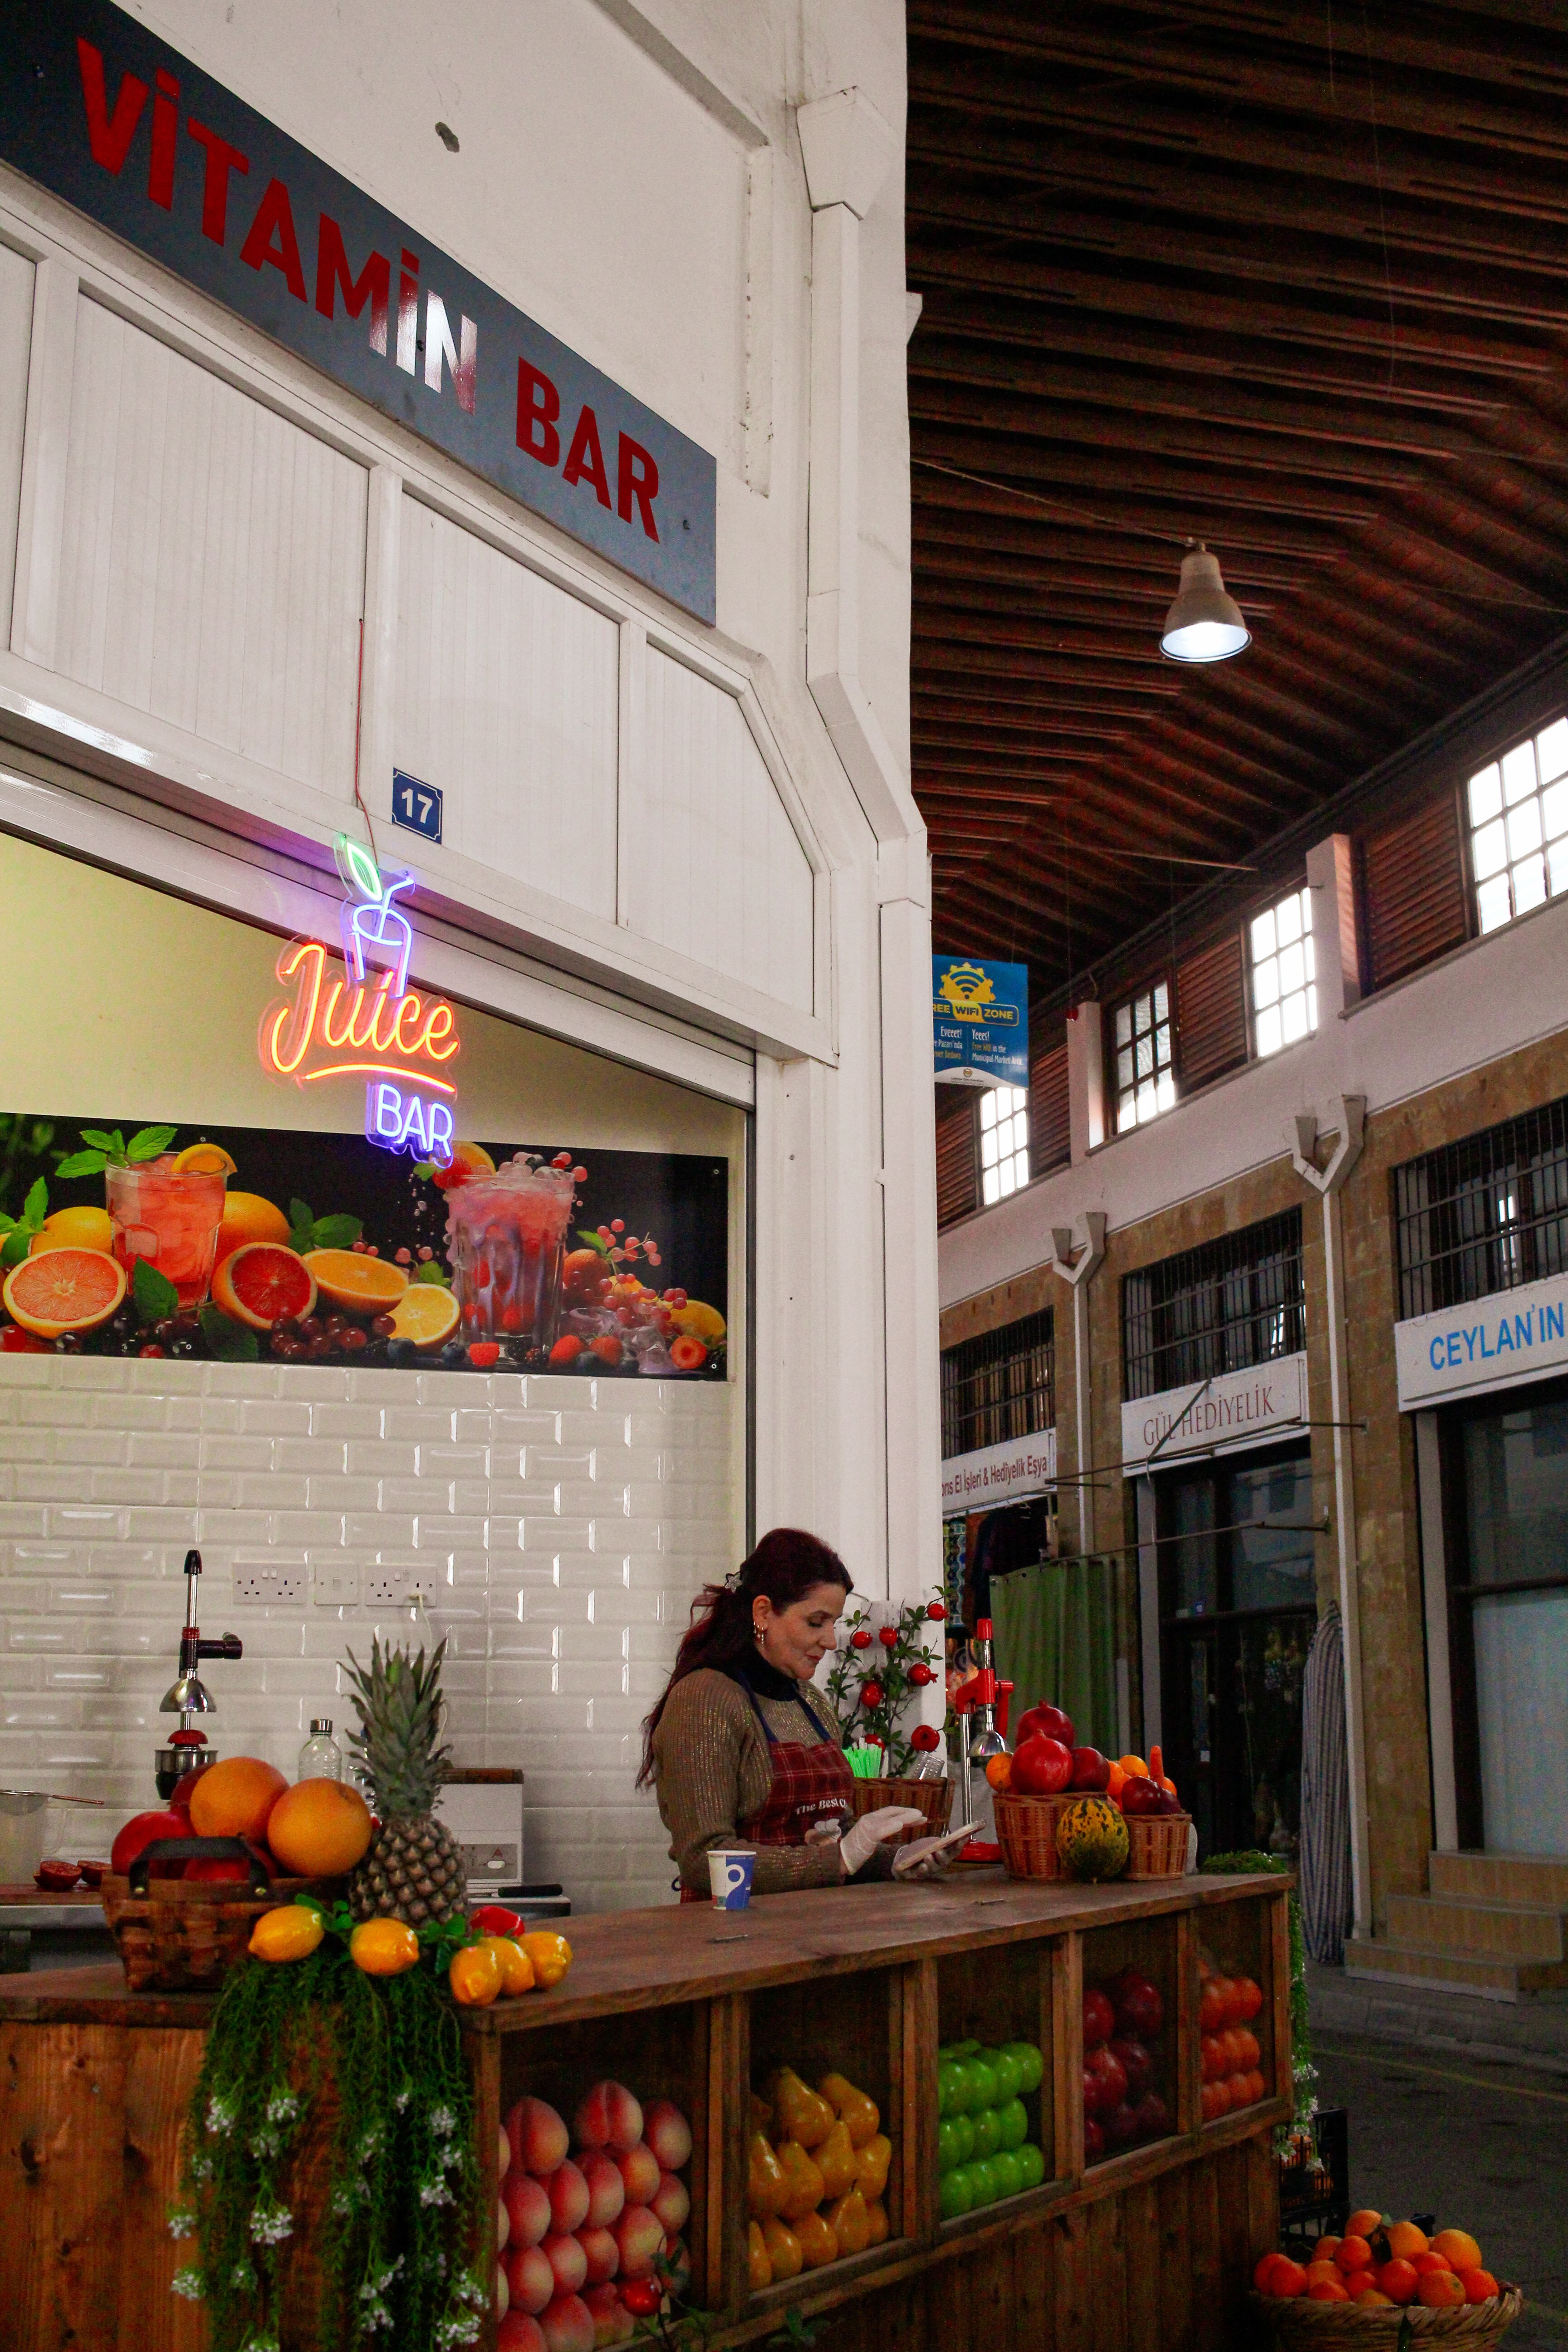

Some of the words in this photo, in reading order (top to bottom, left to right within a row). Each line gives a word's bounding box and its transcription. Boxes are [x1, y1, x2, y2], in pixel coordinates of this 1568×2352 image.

[517, 356, 661, 544] BAR
[401, 788, 433, 824] 17
[270, 943, 459, 1073] Juice
[933, 1003, 950, 1013] REE
[956, 1006, 979, 1016] WIFI
[984, 1009, 1014, 1020] ZONE
[376, 1082, 453, 1158] BAR
[1429, 1302, 1565, 1371] CEYLAN'IN
[1143, 1411, 1176, 1446] GÜL
[1181, 1383, 1275, 1437] HEDİYELİK
[983, 1467, 989, 1486] &
[990, 1457, 1026, 1485] Hediyelik
[1027, 1454, 1047, 1479] Eşya
[795, 1803, 817, 1815] The
